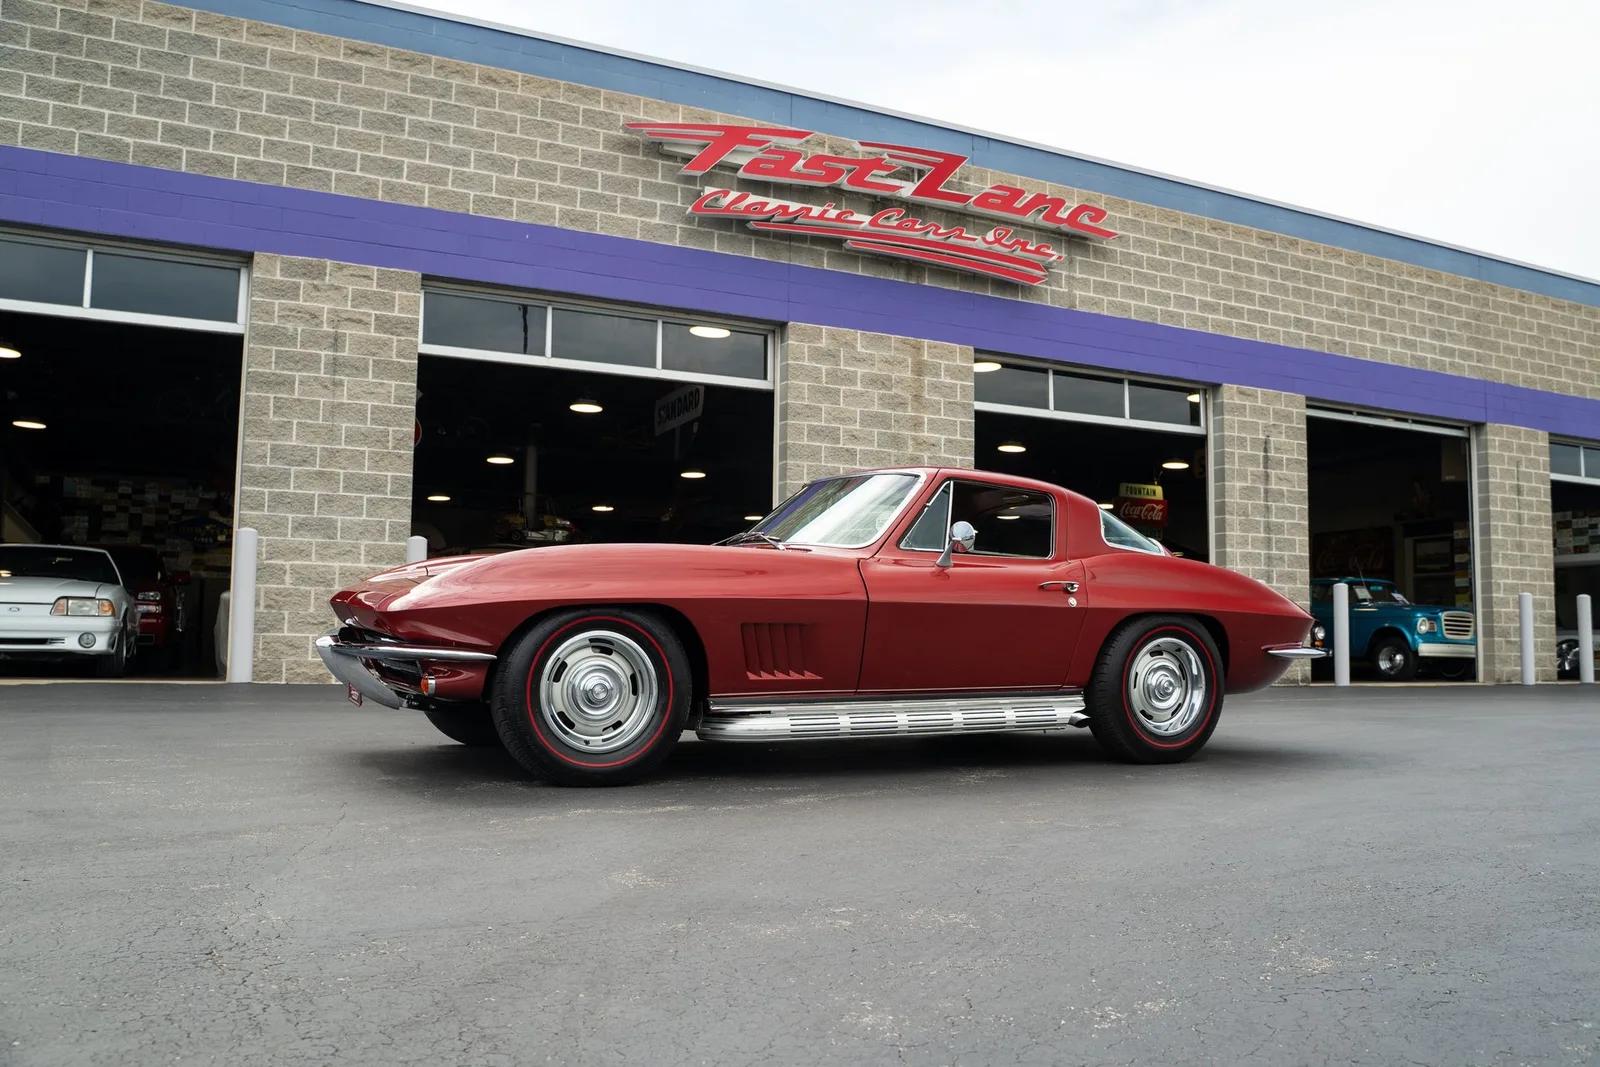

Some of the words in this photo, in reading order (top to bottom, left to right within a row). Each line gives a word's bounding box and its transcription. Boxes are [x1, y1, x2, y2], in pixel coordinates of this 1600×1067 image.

[624, 122, 903, 194] Fast
[857, 141, 1119, 241] Lane
[691, 189, 866, 226] Classic
[868, 207, 978, 243] Cars
[657, 387, 700, 425] STANDARD
[1125, 485, 1157, 497] FOUNTAIN
